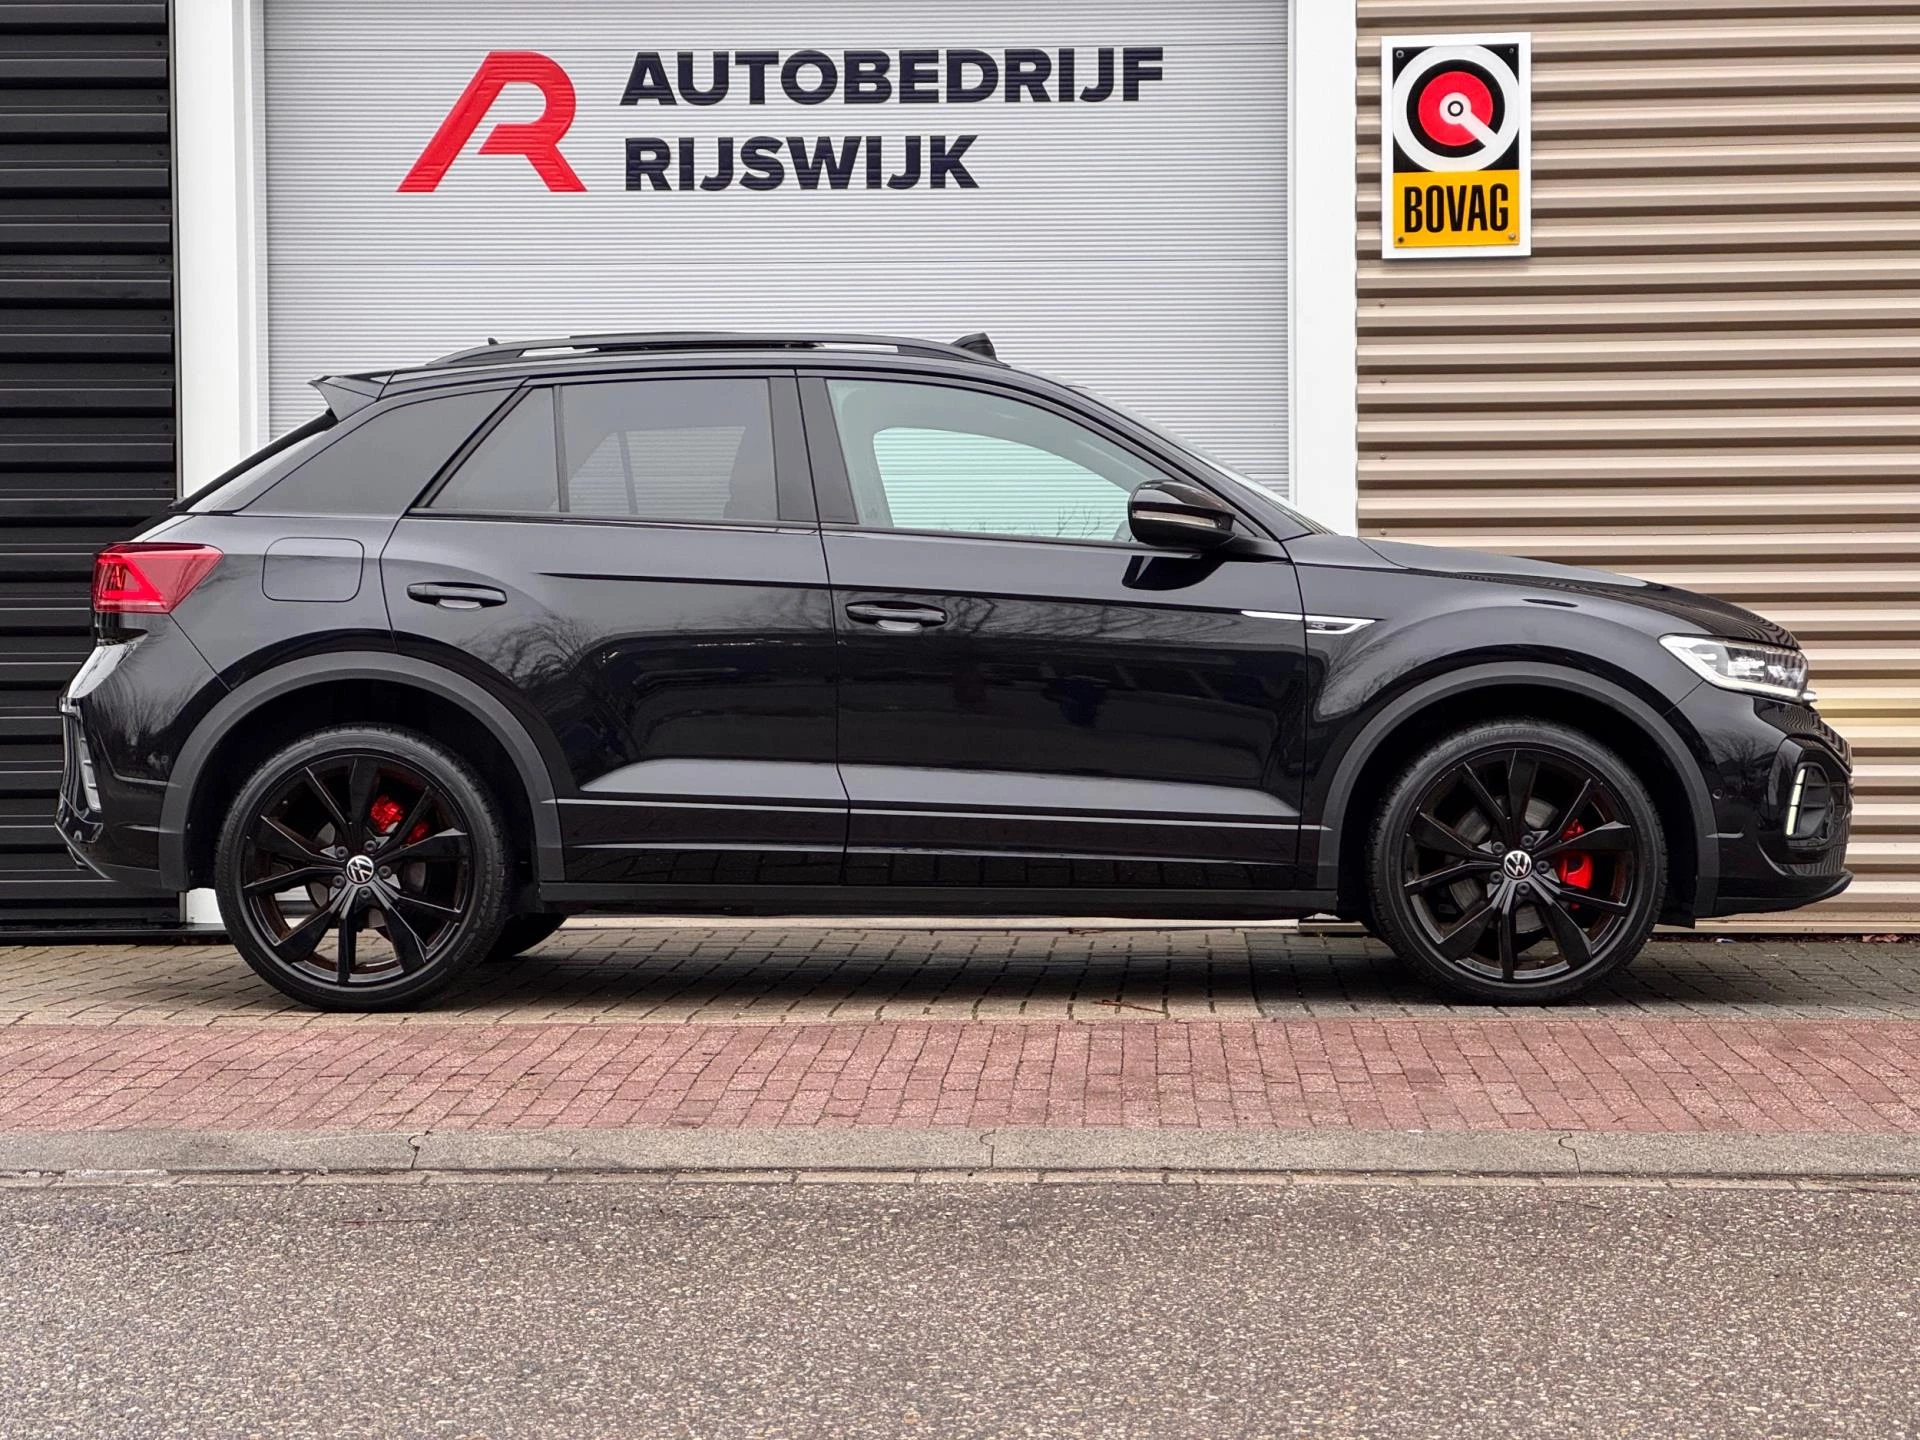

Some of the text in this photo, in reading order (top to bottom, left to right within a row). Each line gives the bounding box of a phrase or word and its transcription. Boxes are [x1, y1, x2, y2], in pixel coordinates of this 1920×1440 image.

[620, 47, 1163, 106] AUTOBEDRIJF
[625, 134, 979, 192] RIJSWIJK
[1404, 182, 1508, 233] BOVAG
